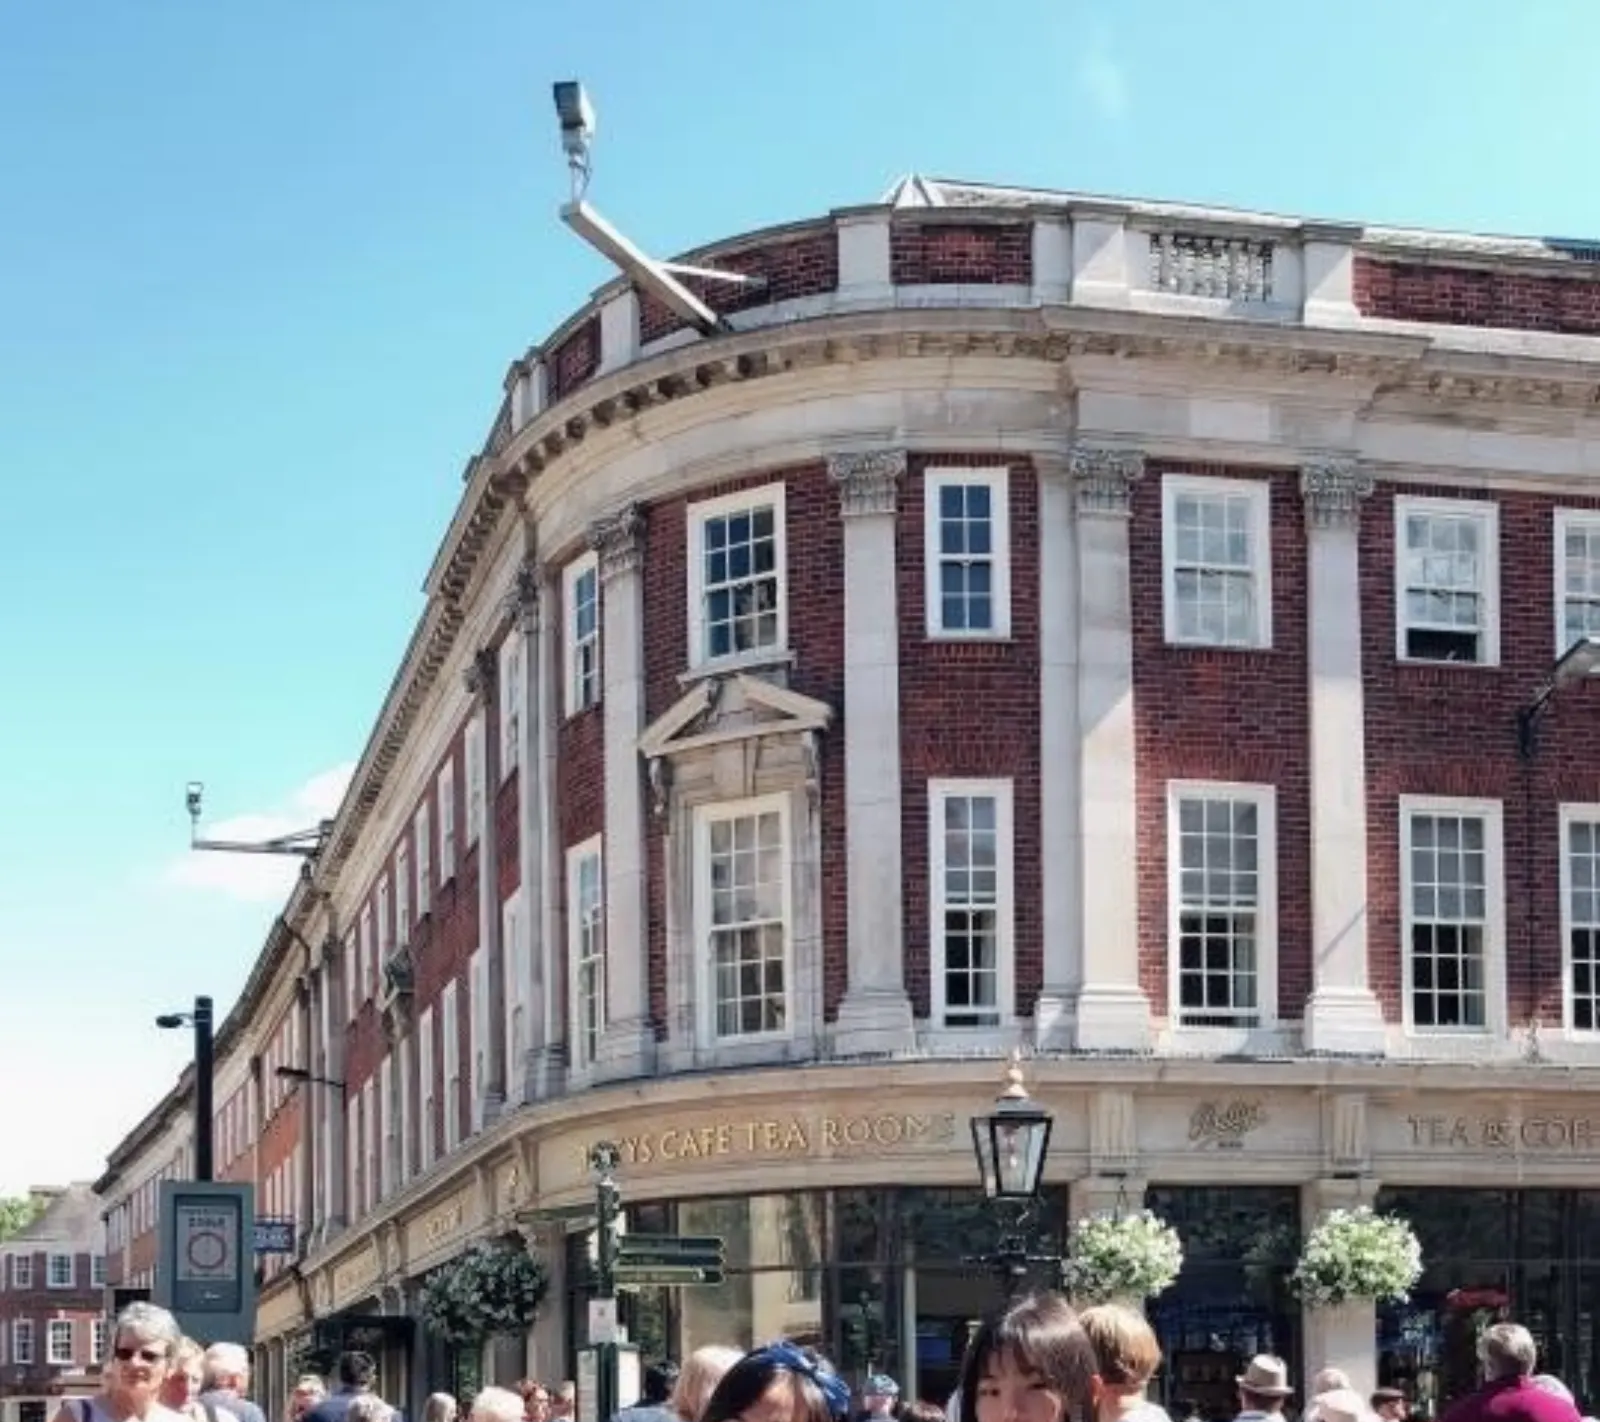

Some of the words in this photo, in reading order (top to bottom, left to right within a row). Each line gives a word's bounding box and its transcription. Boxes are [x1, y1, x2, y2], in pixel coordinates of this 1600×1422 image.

[659, 1124, 733, 1160] CAFE
[747, 1118, 808, 1150] TEA
[1407, 1114, 1471, 1148] TEA
